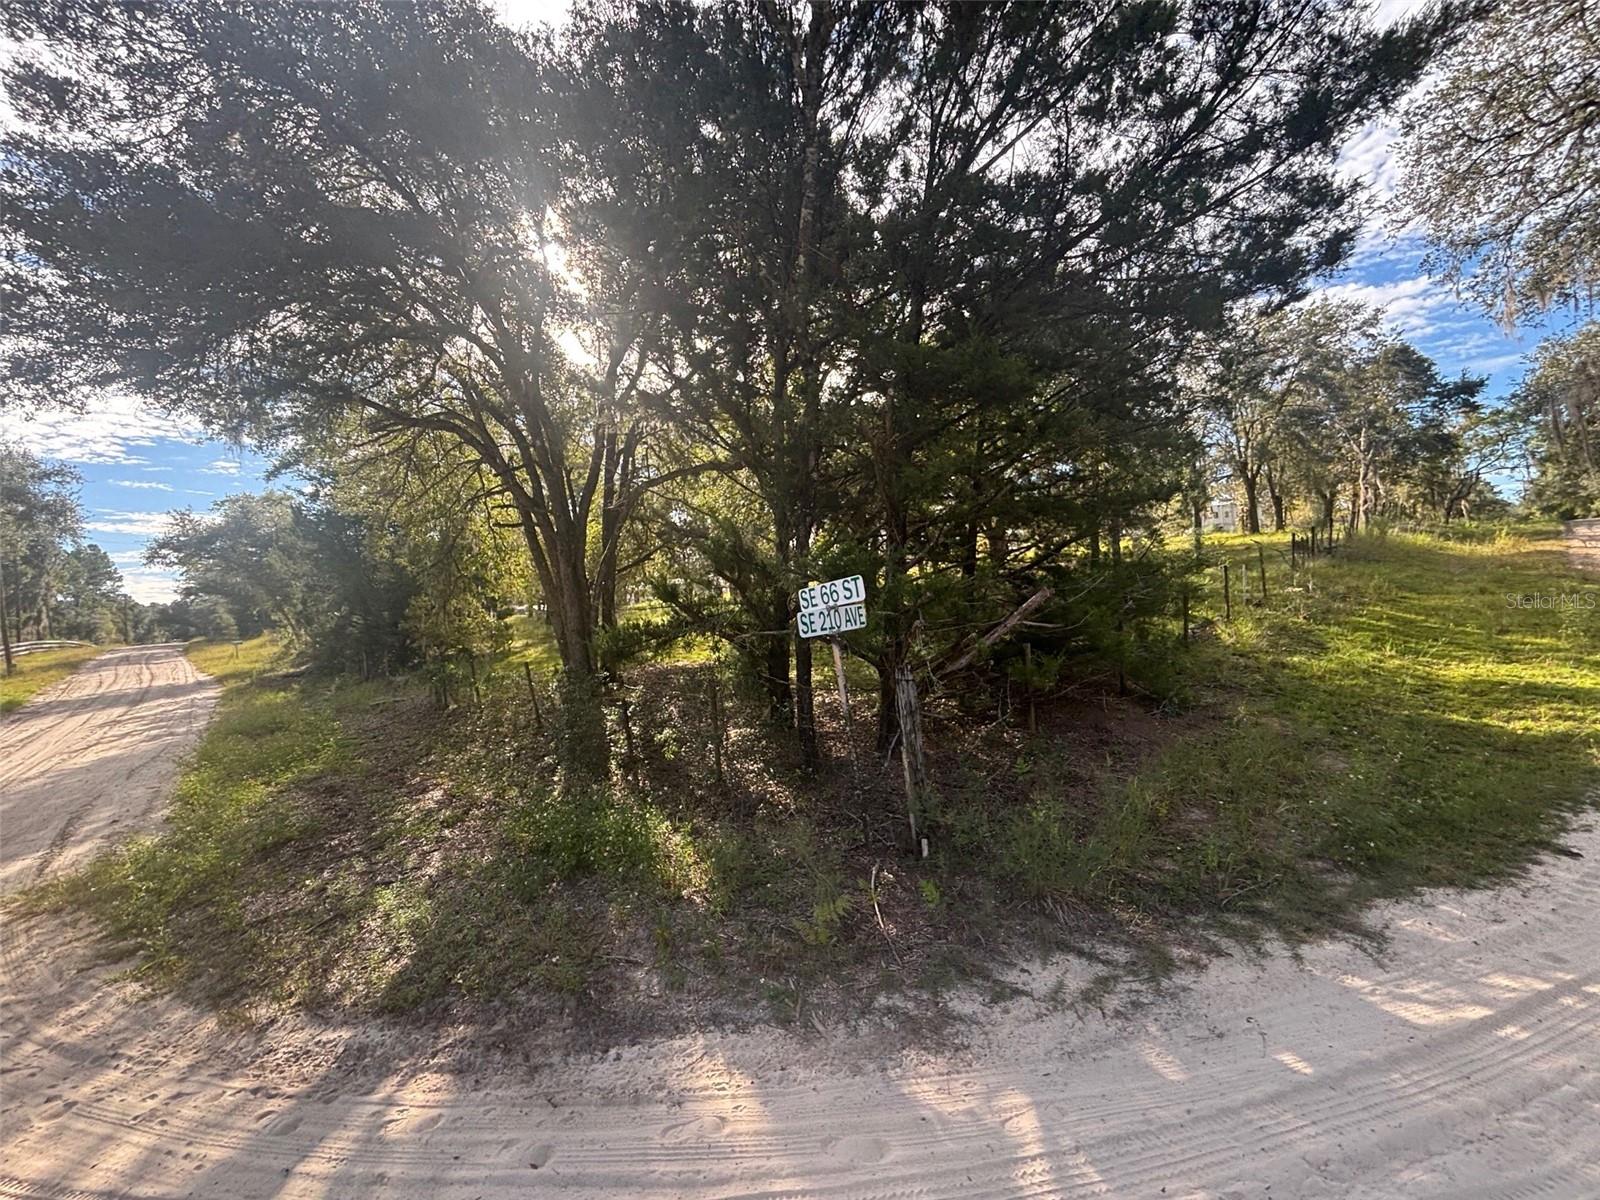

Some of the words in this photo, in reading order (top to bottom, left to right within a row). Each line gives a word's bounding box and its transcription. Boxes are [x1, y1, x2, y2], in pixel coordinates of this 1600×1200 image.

[800, 588, 818, 609] SE
[820, 583, 839, 604] 66
[842, 577, 860, 600] ST
[800, 613, 817, 634] SE
[818, 609, 841, 631] 210
[845, 606, 865, 628] AVE
